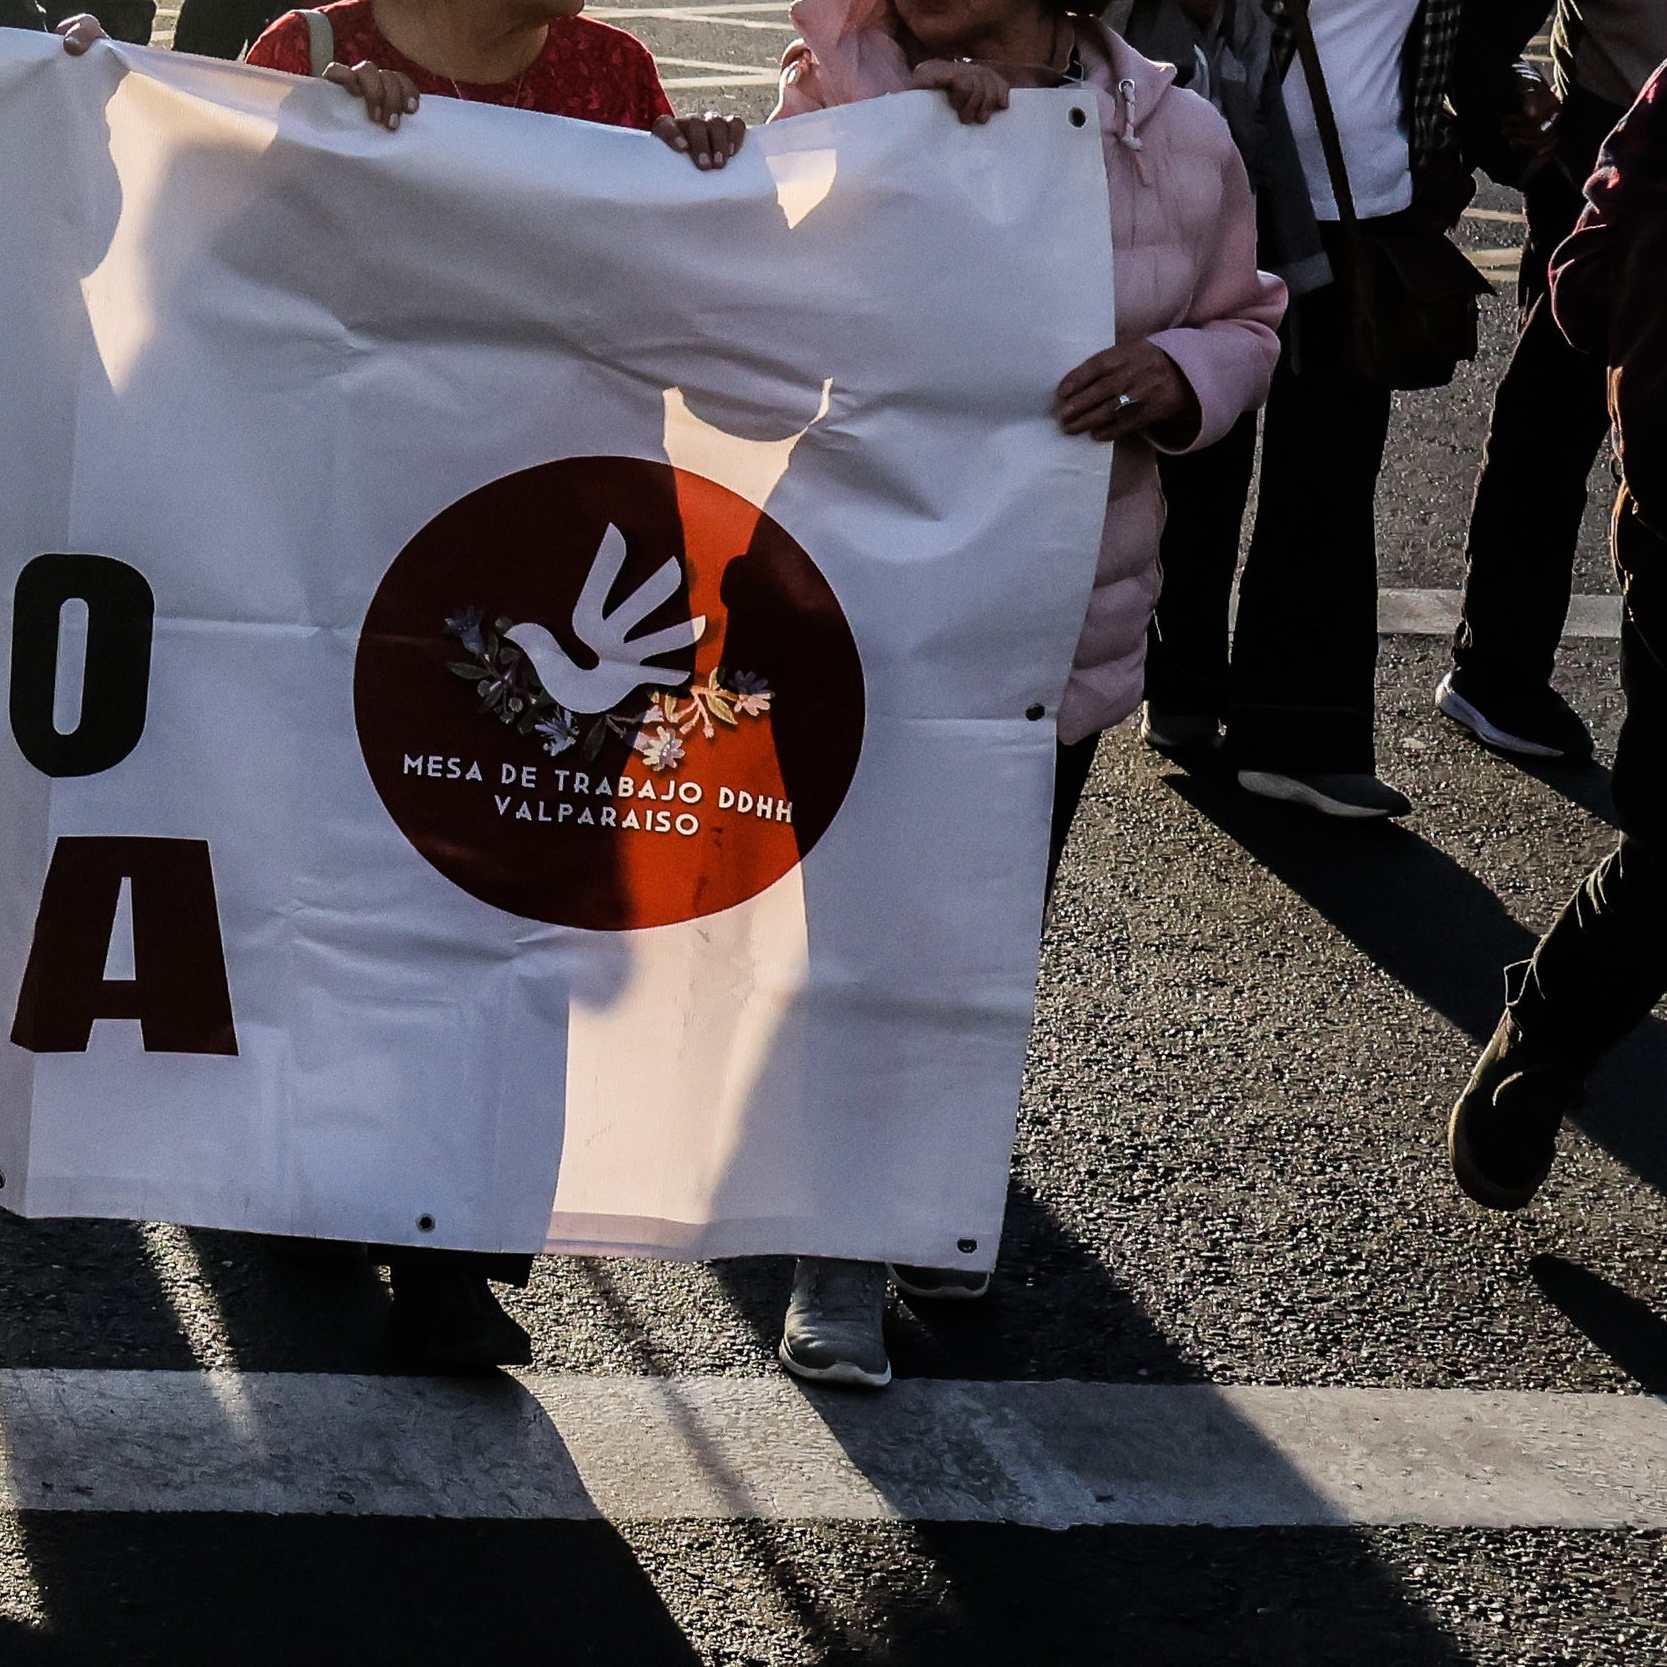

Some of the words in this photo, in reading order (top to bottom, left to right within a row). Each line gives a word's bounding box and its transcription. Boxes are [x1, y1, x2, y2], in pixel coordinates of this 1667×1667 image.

[404, 753, 482, 782] MESA
[501, 764, 537, 788] DE
[555, 769, 703, 804] TRABAJO
[719, 788, 793, 824] DDHH
[494, 794, 699, 835] VALPARAISO
